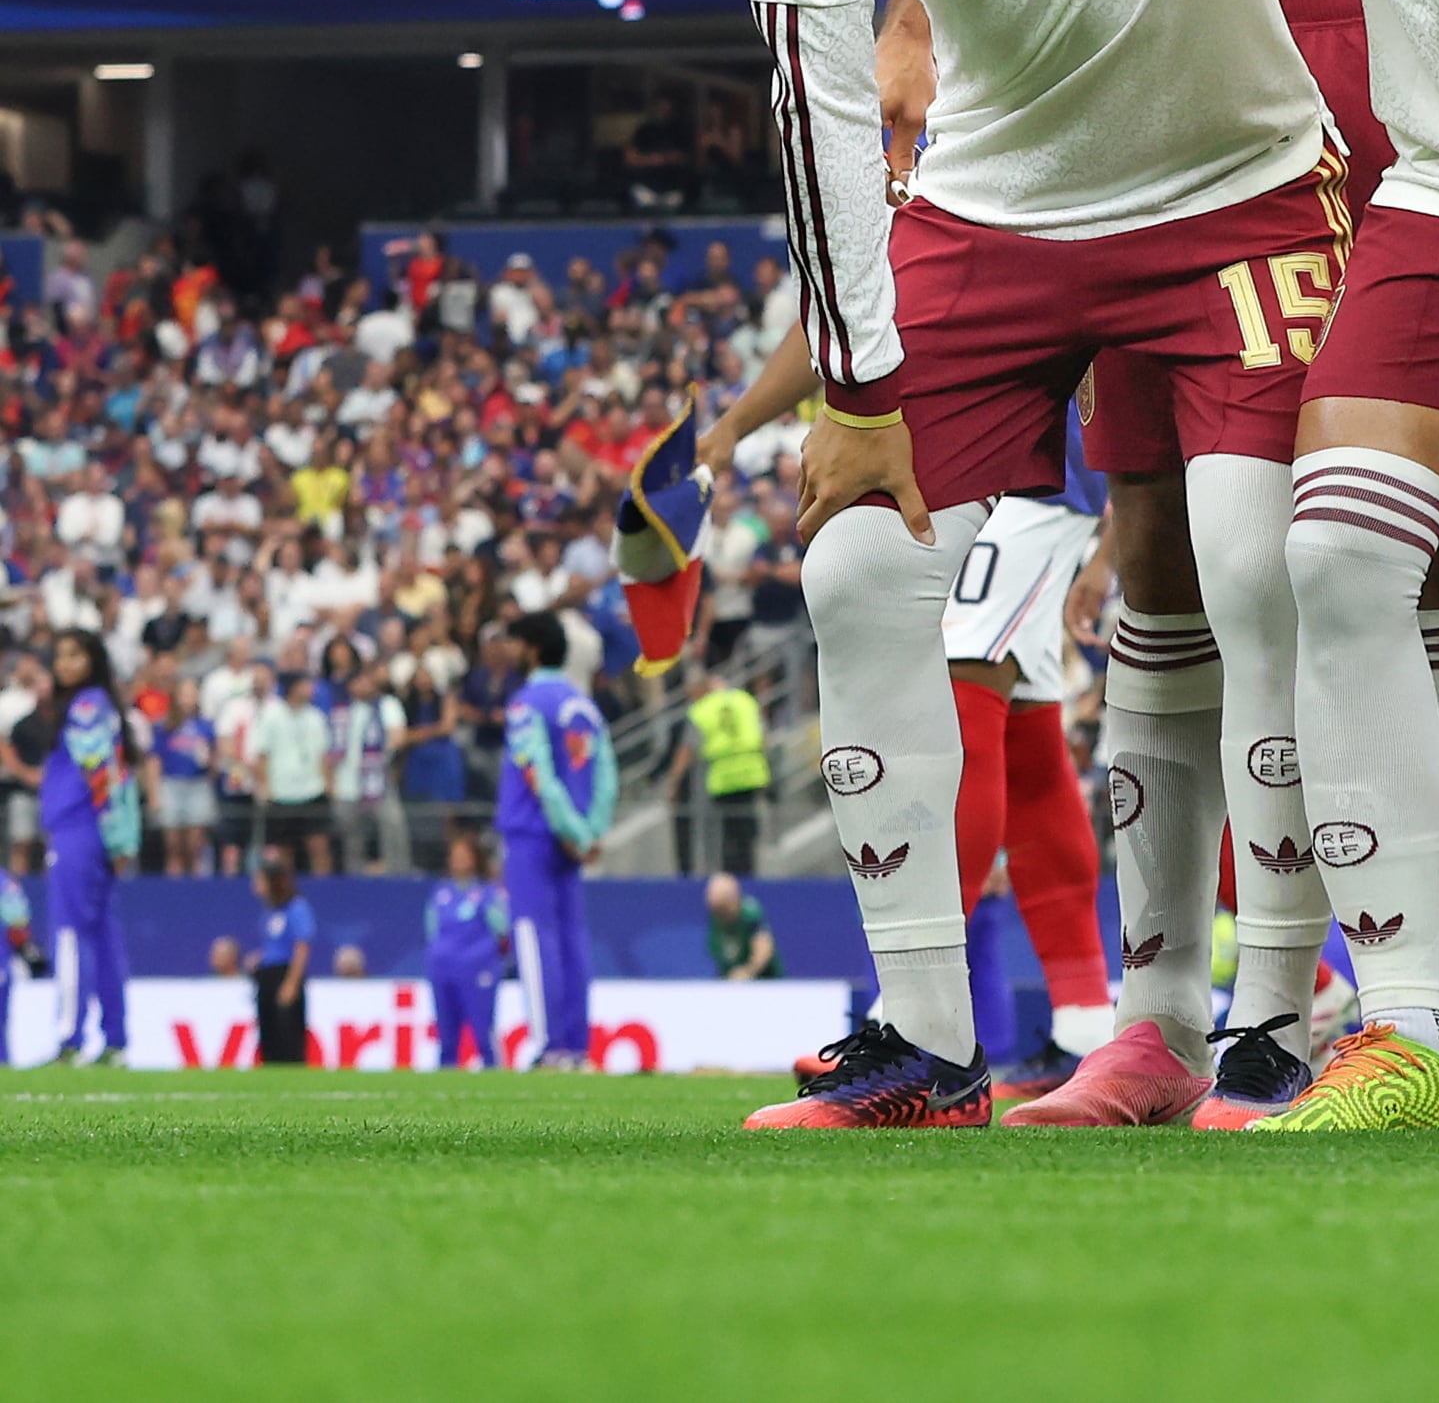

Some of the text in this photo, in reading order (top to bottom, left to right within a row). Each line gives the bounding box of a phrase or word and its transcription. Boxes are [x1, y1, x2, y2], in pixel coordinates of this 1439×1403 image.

[1218, 252, 1334, 371] 15
[955, 542, 1000, 604] 0
[1261, 748, 1297, 762] RF
[828, 756, 862, 771] RF
[1260, 763, 1298, 777] EF
[831, 770, 866, 785] EF
[1320, 830, 1355, 844] RF
[1323, 844, 1359, 859] EF
[172, 983, 659, 1072] vrin
